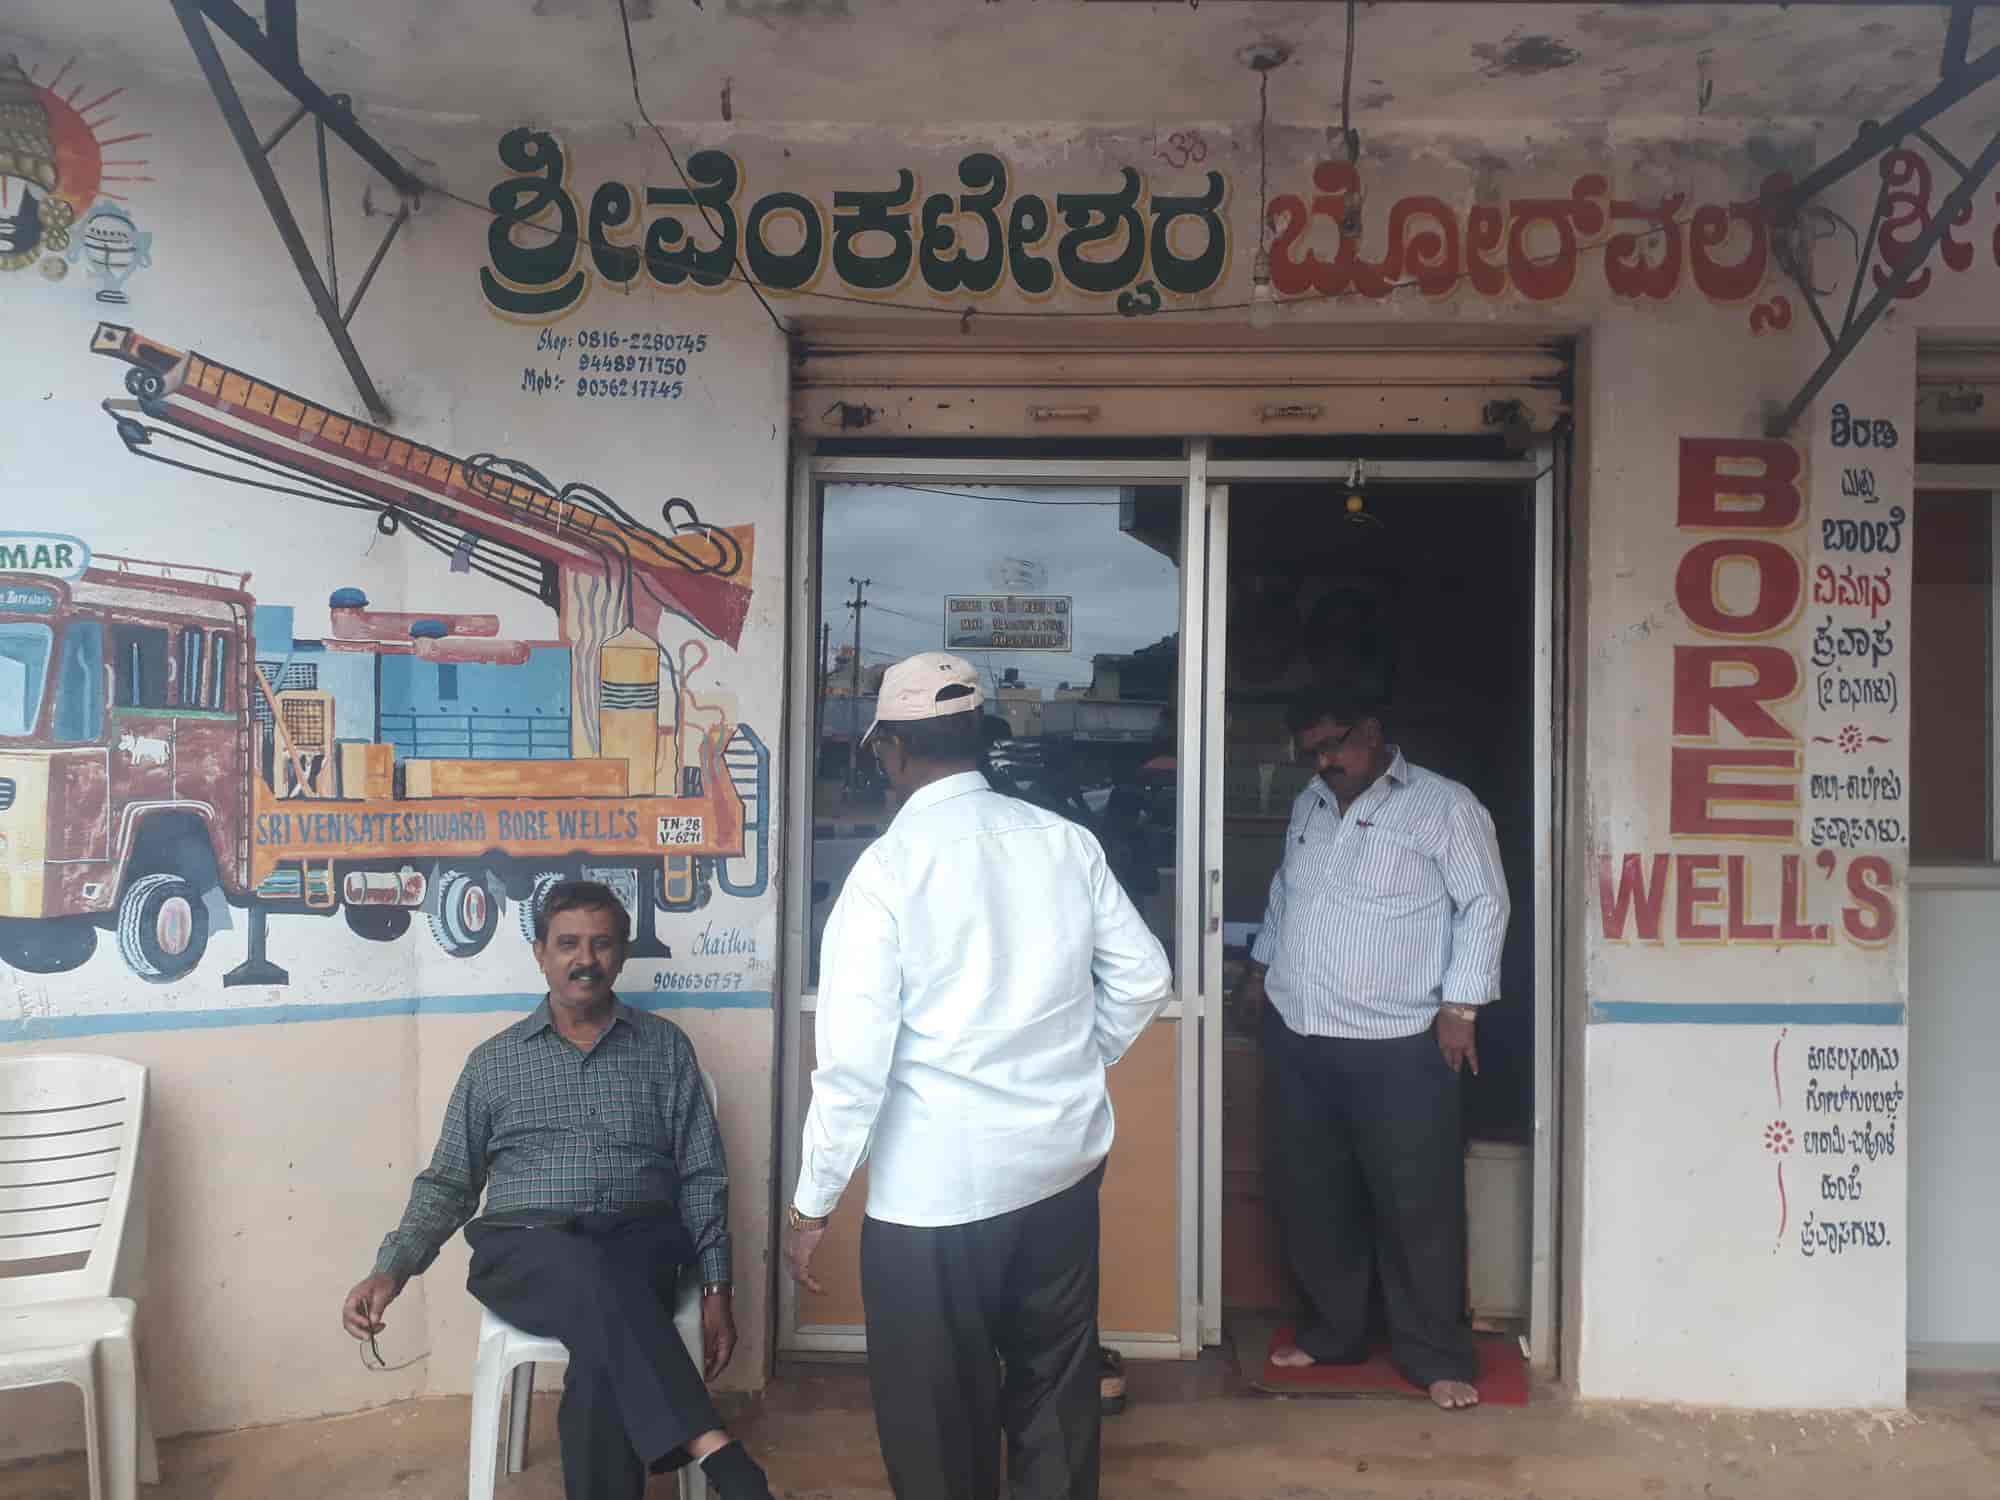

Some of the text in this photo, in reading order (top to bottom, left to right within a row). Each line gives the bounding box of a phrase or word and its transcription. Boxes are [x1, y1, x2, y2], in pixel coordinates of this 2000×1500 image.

[577, 330, 708, 354] 0816-2280745
[578, 353, 687, 376] 9448971750
[576, 377, 683, 399] 9036217745
[1822, 506, 1905, 553] ಬಾಂಬೆ
[1813, 564, 1891, 619] ವಿಮಾನ
[1670, 437, 1806, 840] BORE
[1811, 615, 1893, 668] ಪ್ರವಾಸ
[256, 812, 290, 846] SRI
[497, 809, 552, 841] BORE
